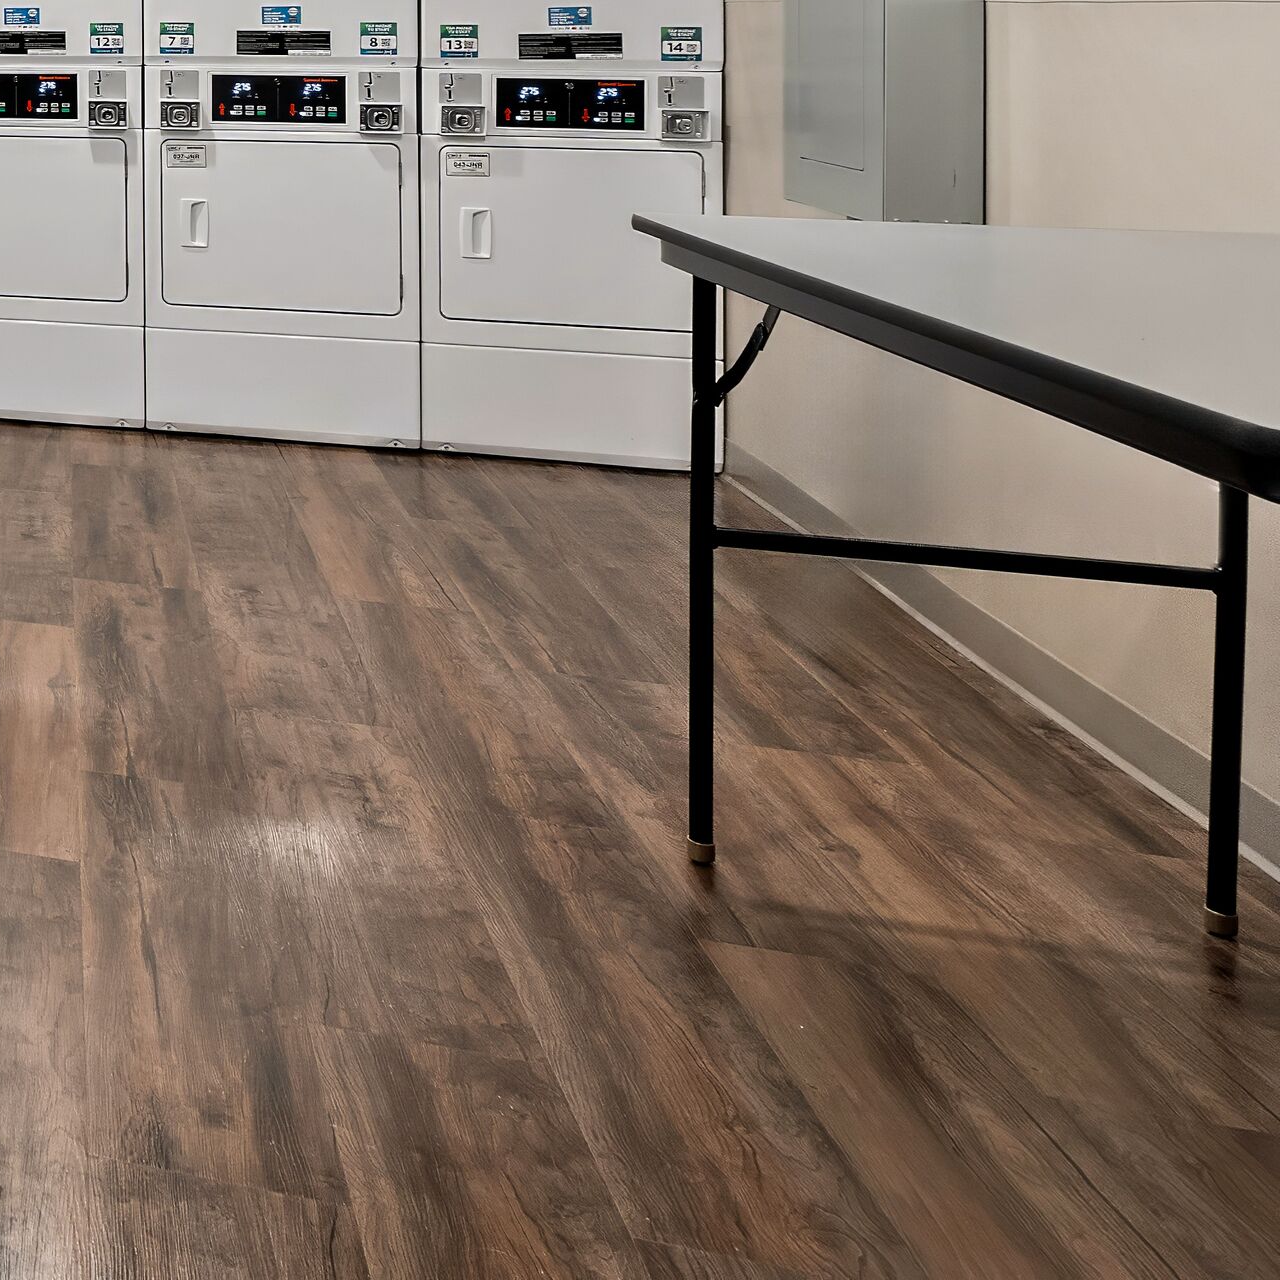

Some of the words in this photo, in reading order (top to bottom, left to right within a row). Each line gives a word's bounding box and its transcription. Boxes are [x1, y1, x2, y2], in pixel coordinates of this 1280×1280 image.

[95, 37, 110, 46] 12
[168, 36, 176, 46] 7
[370, 38, 378, 47] 8
[446, 40, 462, 50] 13
[667, 43, 683, 52] 14
